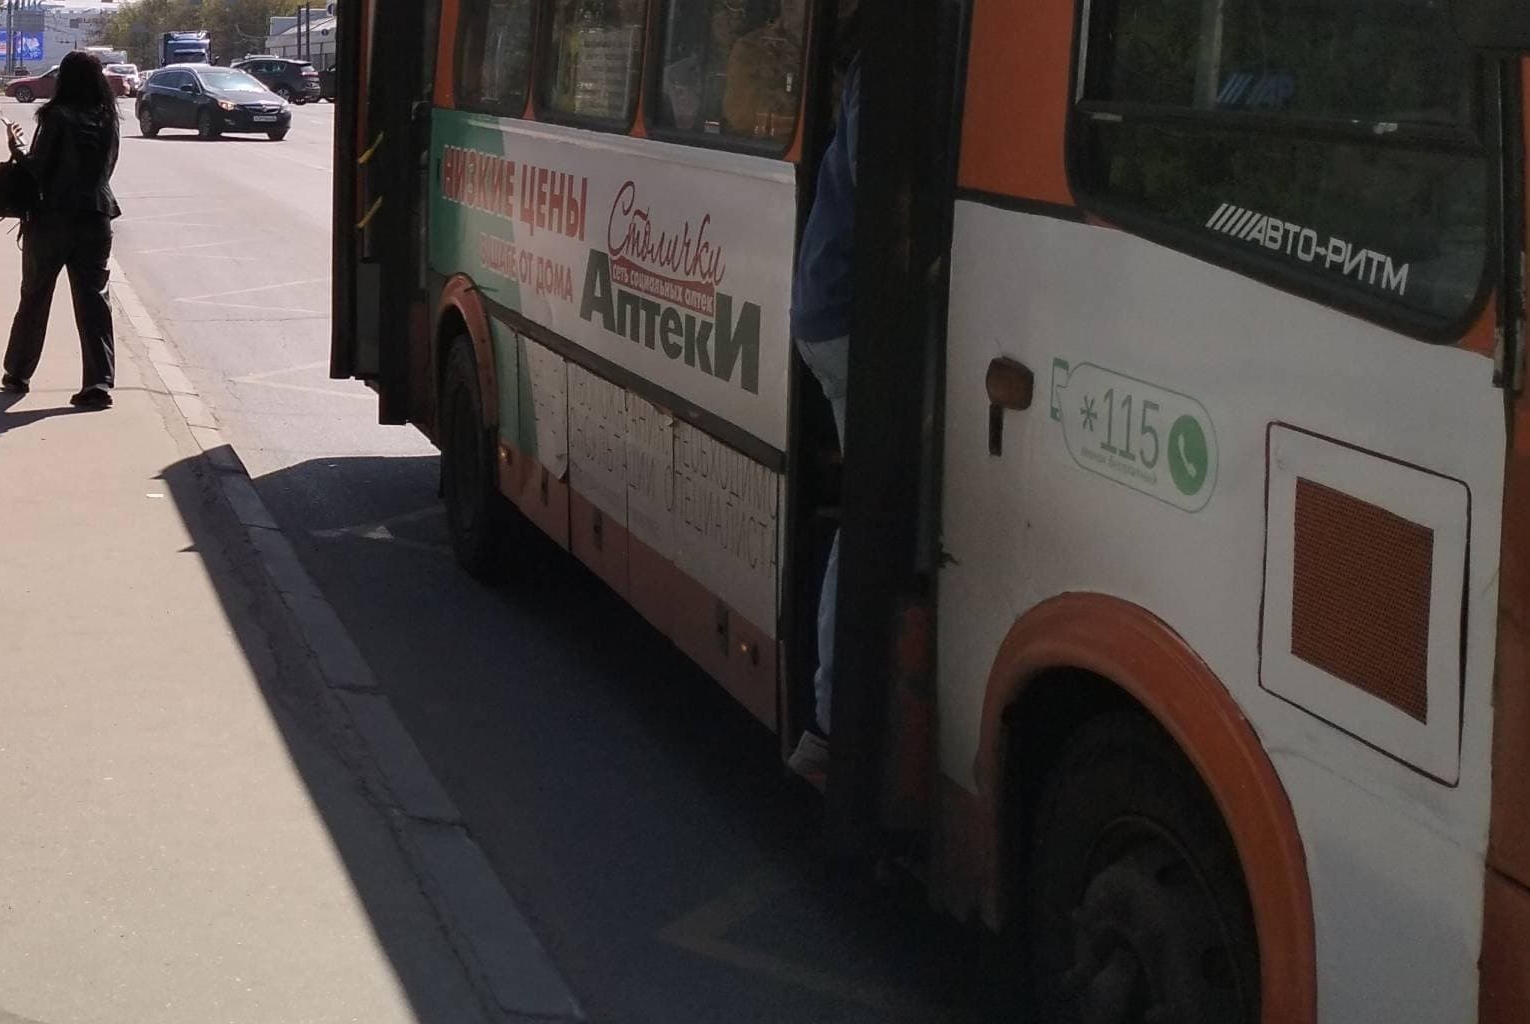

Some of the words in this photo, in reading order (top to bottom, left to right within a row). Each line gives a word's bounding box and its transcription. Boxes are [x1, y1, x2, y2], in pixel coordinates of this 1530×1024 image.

[441, 144, 516, 220] НИЗКИЕ
[520, 163, 587, 242] ЦЕНЫ
[608, 180, 726, 285] Столички
[685, 288, 714, 313] аптек
